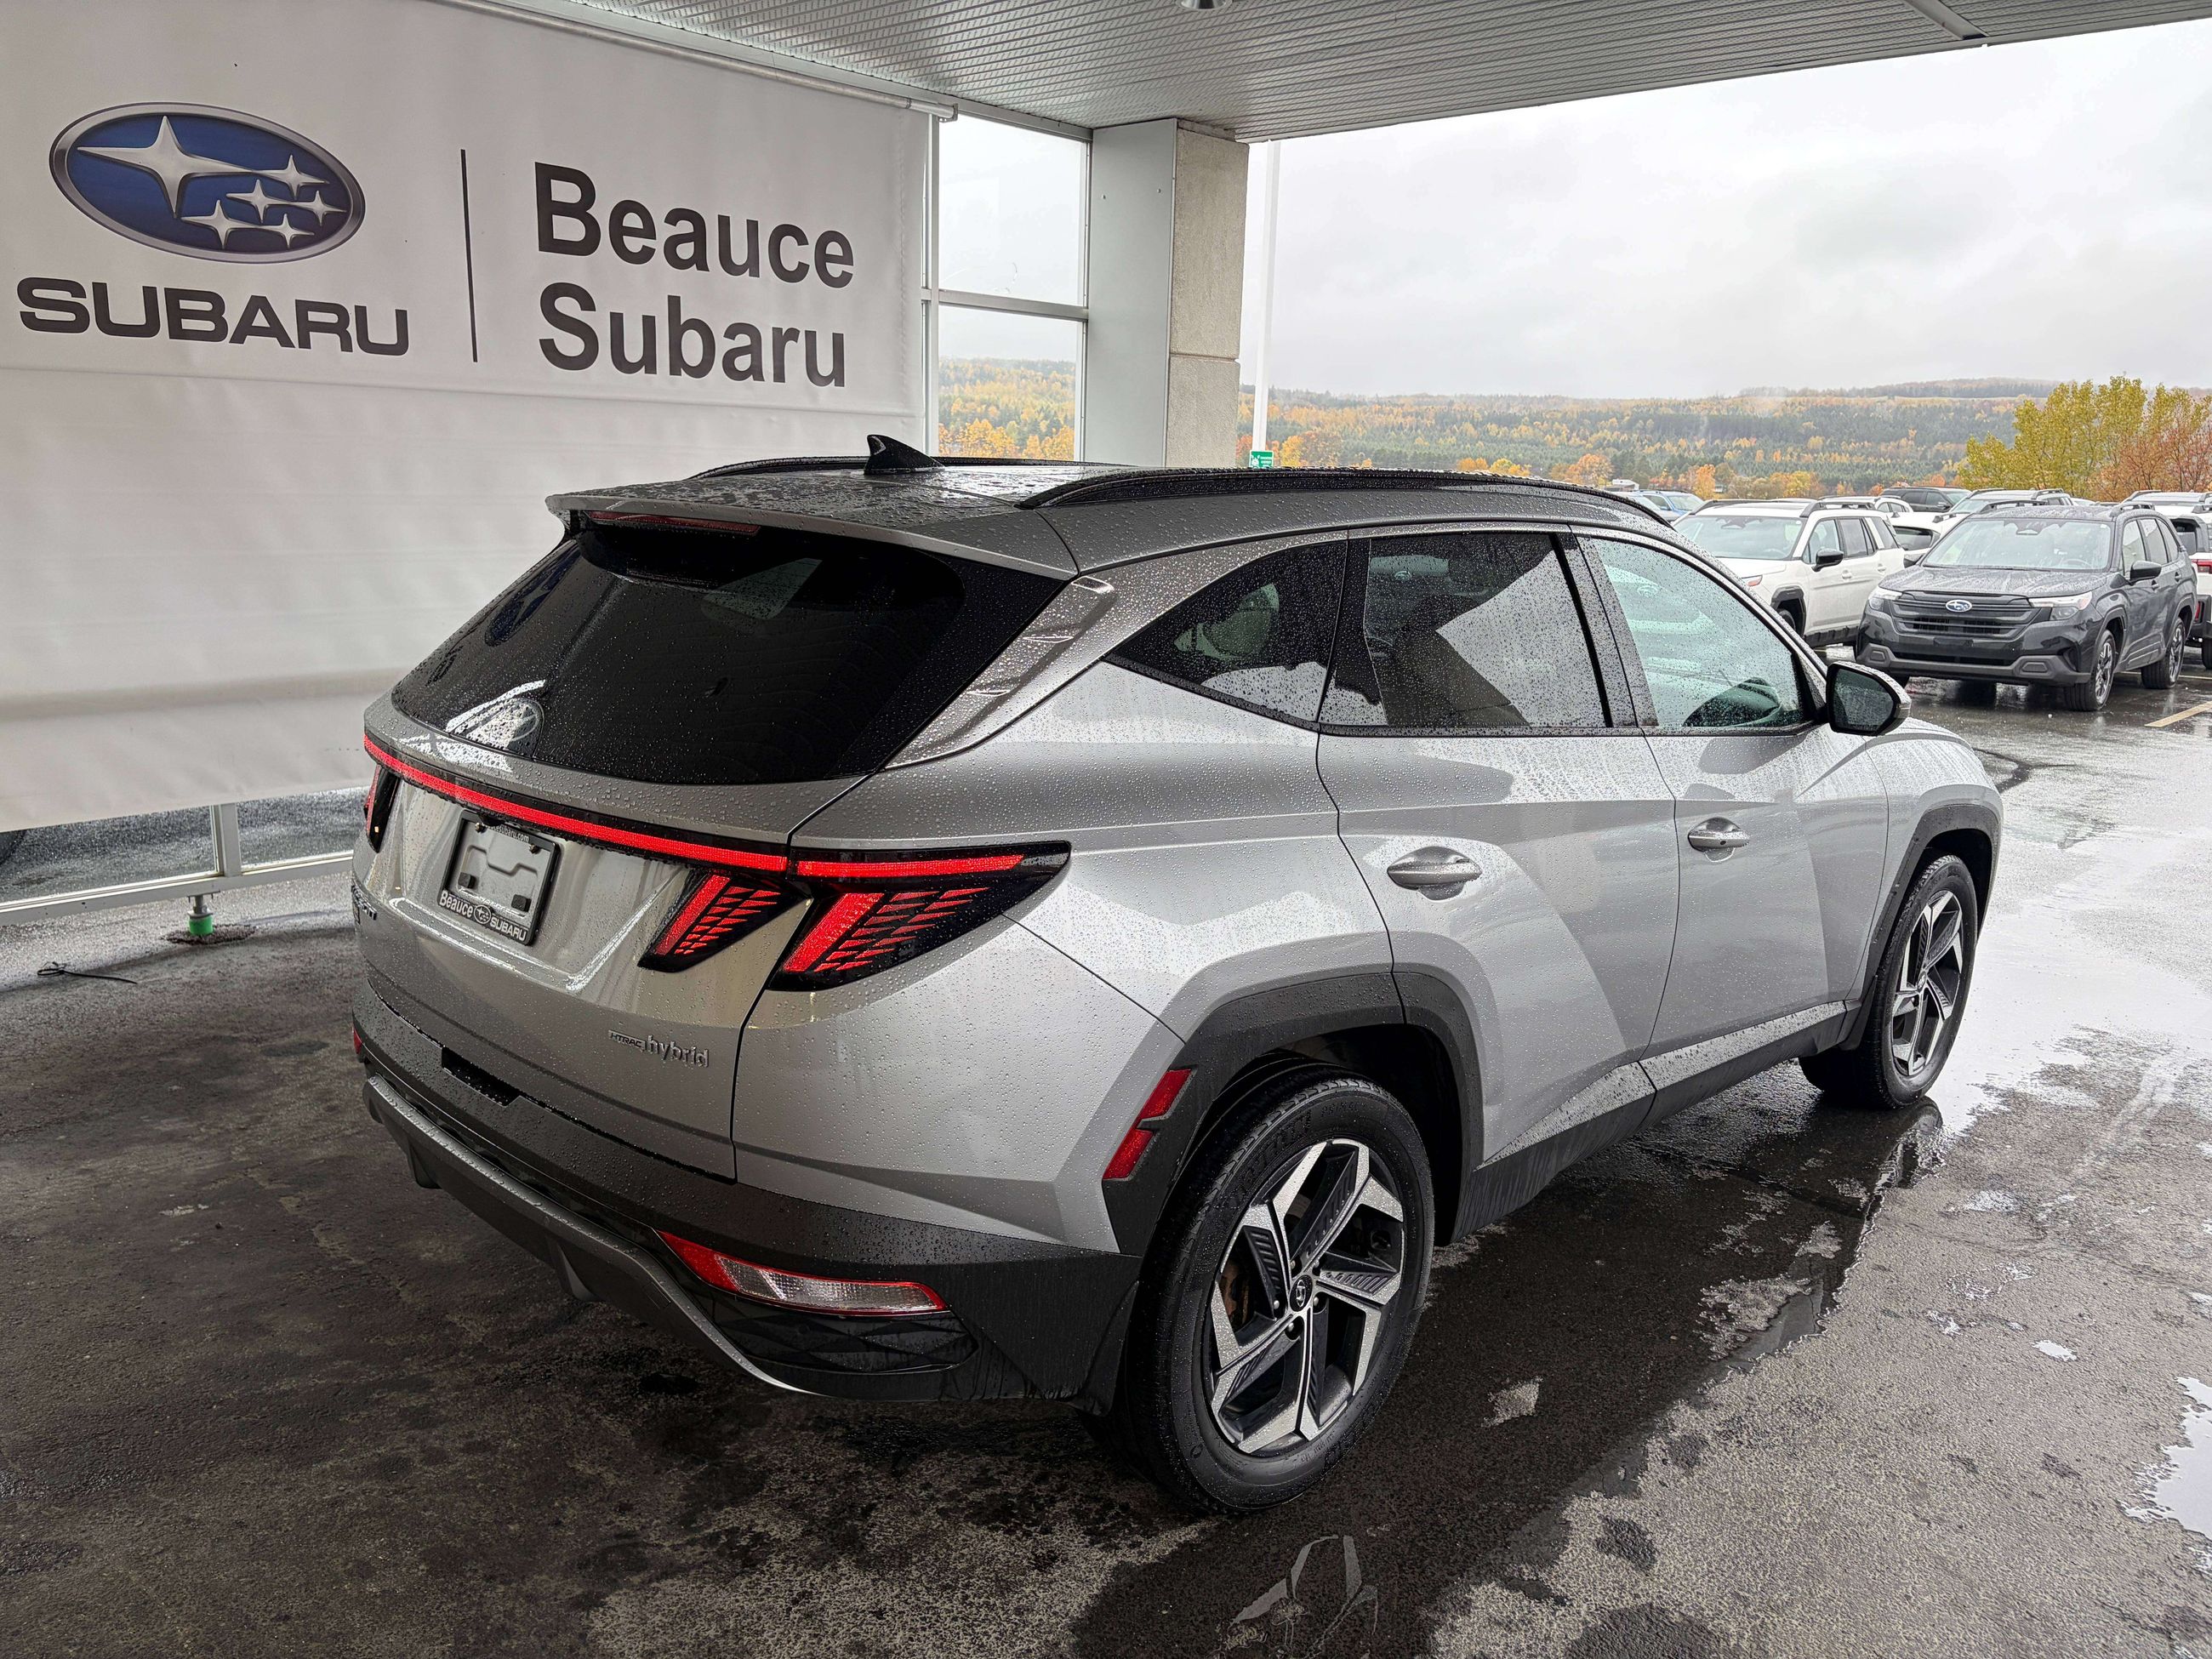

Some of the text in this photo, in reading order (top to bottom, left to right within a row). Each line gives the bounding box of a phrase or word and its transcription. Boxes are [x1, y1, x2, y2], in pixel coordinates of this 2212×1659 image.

[534, 162, 854, 288] Beauce
[16, 276, 409, 356] SUBARU
[539, 282, 846, 388] Subaru
[439, 890, 527, 942] Beauce SUBARU
[610, 1031, 710, 1068] HTRAC hybrid
